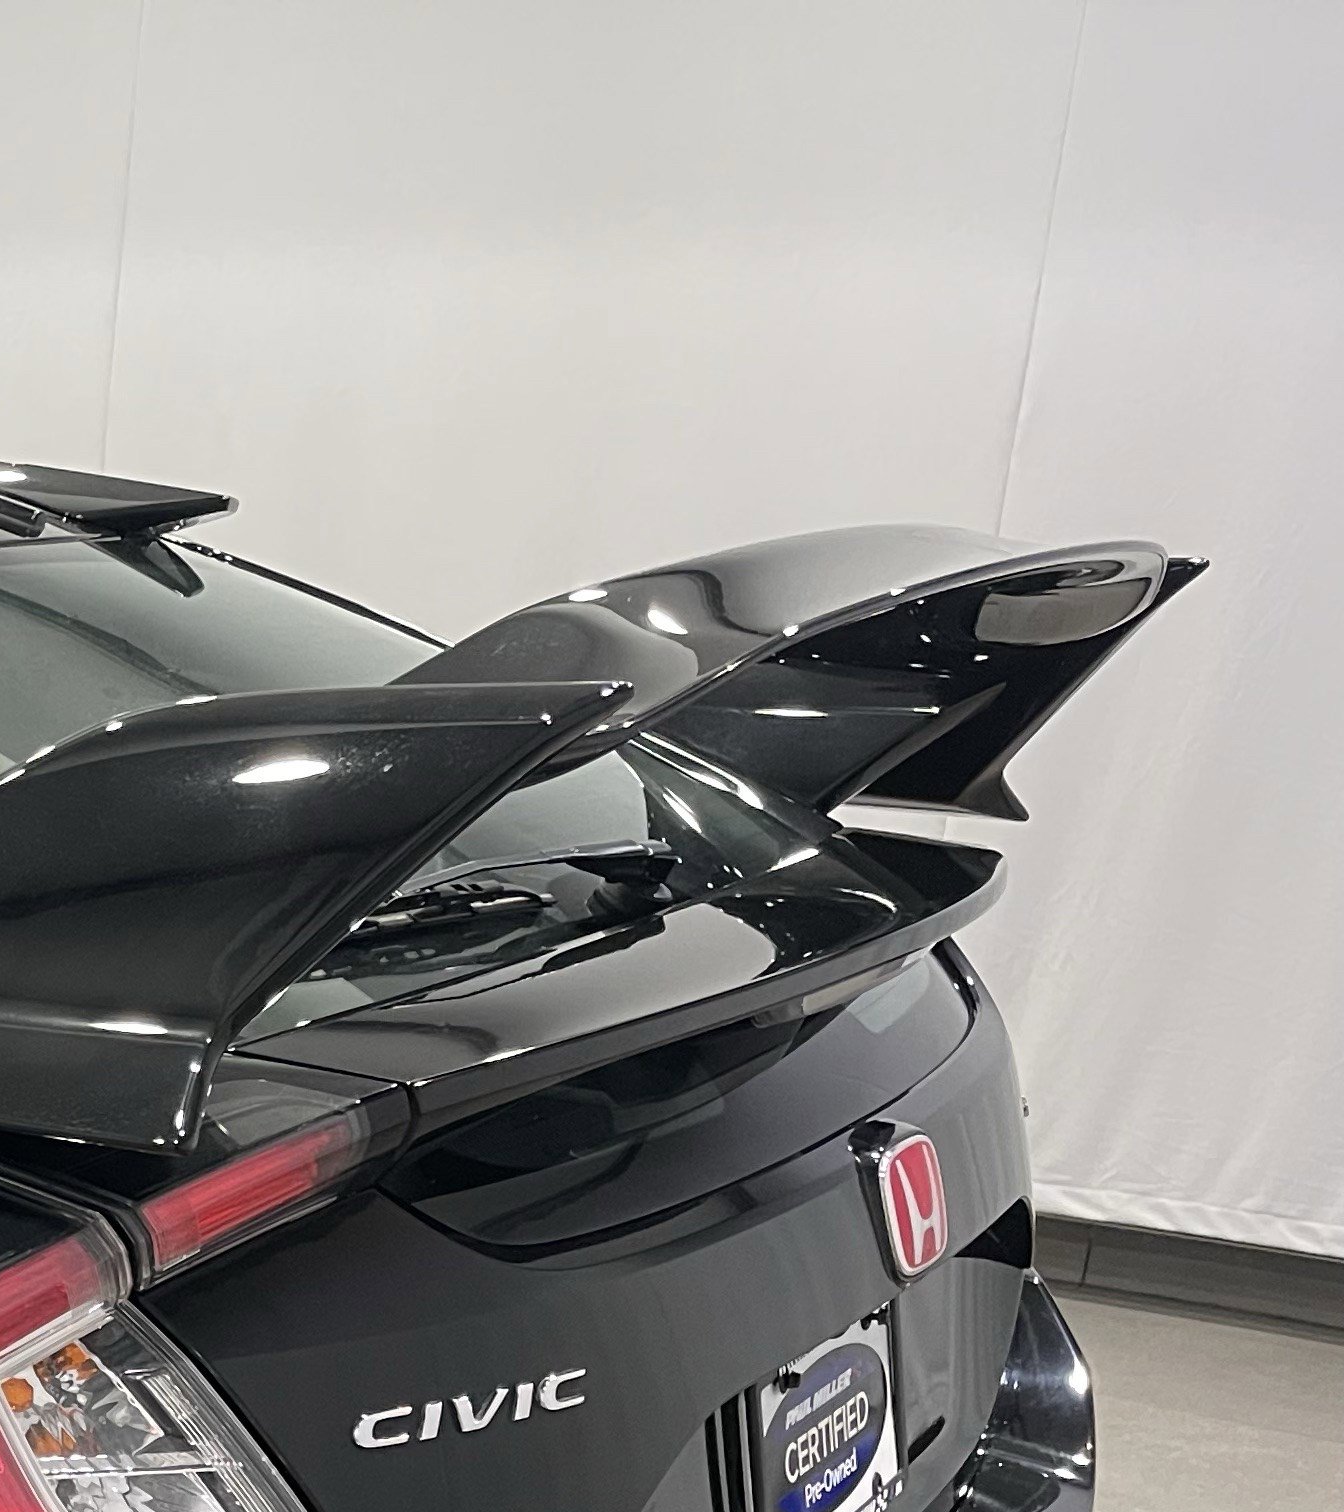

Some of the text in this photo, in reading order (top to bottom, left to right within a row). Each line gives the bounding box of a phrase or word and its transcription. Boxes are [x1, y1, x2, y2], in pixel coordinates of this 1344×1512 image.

[353, 1368, 586, 1448] CIVIC
[784, 1391, 869, 1484] CERTIFIED
[804, 1446, 858, 1508] Pre-Owned
